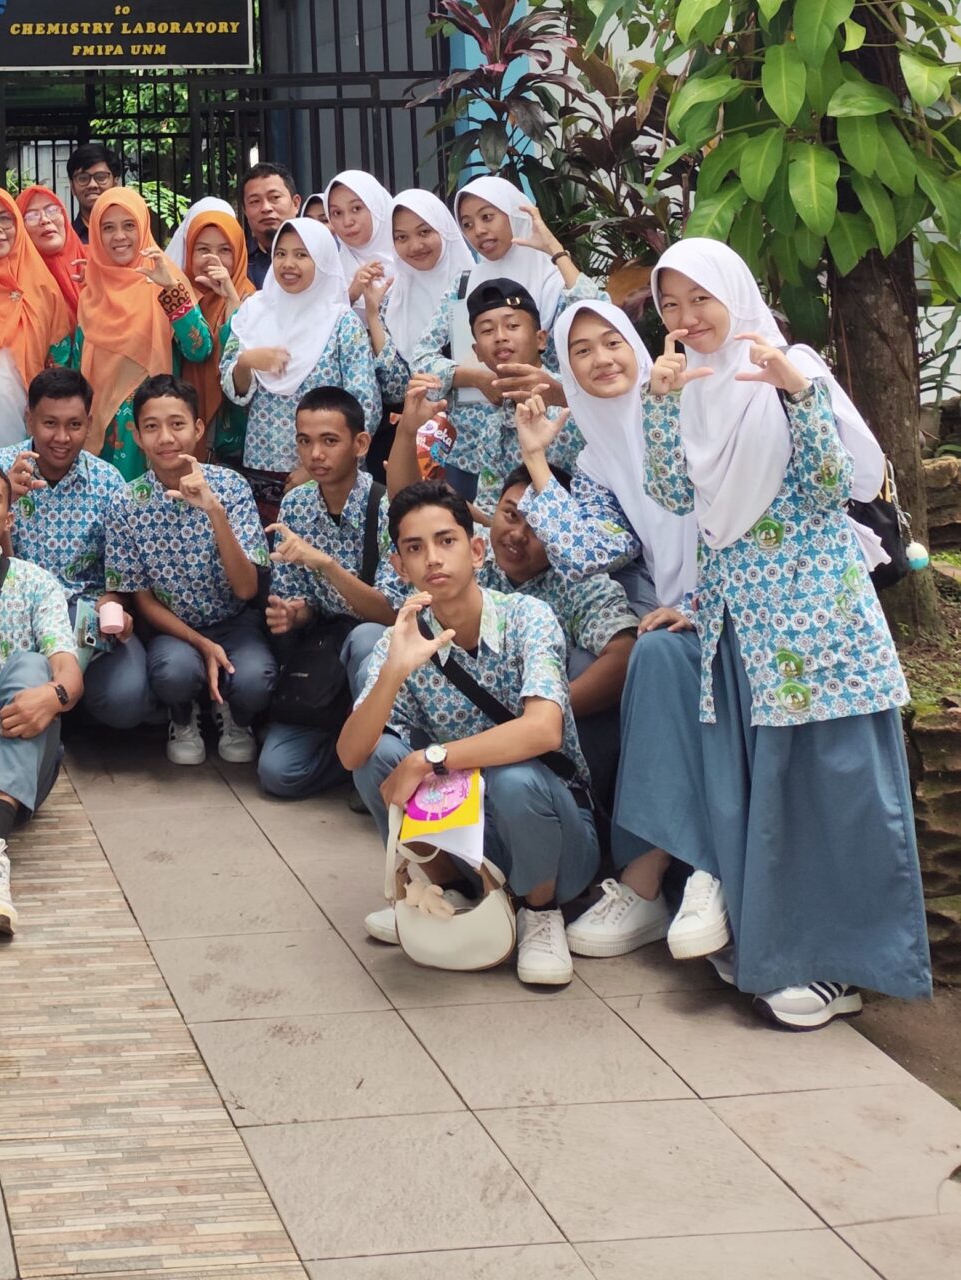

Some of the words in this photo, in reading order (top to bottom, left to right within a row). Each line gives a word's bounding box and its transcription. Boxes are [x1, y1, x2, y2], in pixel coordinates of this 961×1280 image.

[114, 5, 131, 16] to
[9, 21, 115, 36] CHEMISTRY
[121, 21, 240, 35] LABORATORY
[71, 44, 124, 57] FMIPA
[130, 44, 167, 56] UNM
